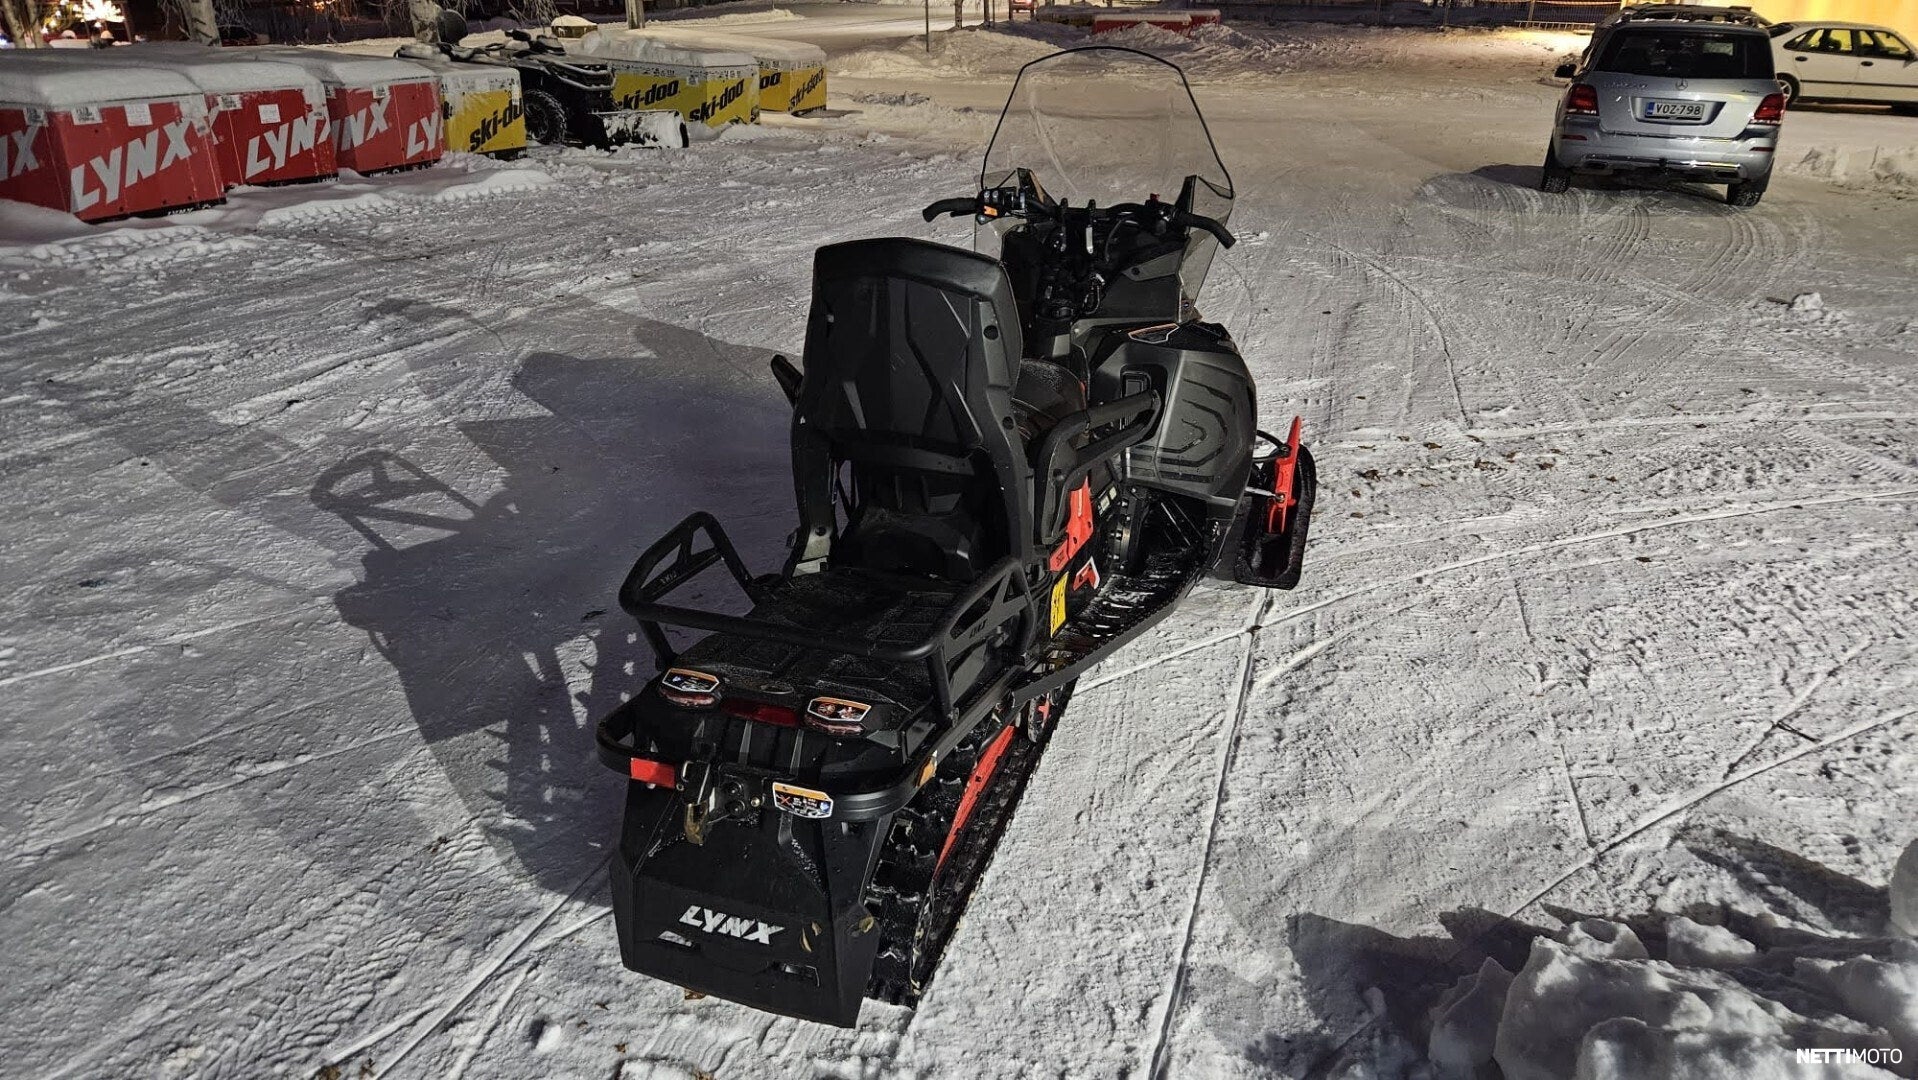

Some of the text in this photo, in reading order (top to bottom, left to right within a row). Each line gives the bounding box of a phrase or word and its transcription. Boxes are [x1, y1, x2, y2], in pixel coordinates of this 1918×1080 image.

[690, 79, 745, 123] ski-doo
[1655, 103, 1702, 116] VOZ-798
[70, 118, 192, 214] LYNX
[678, 905, 786, 945] LYNX
